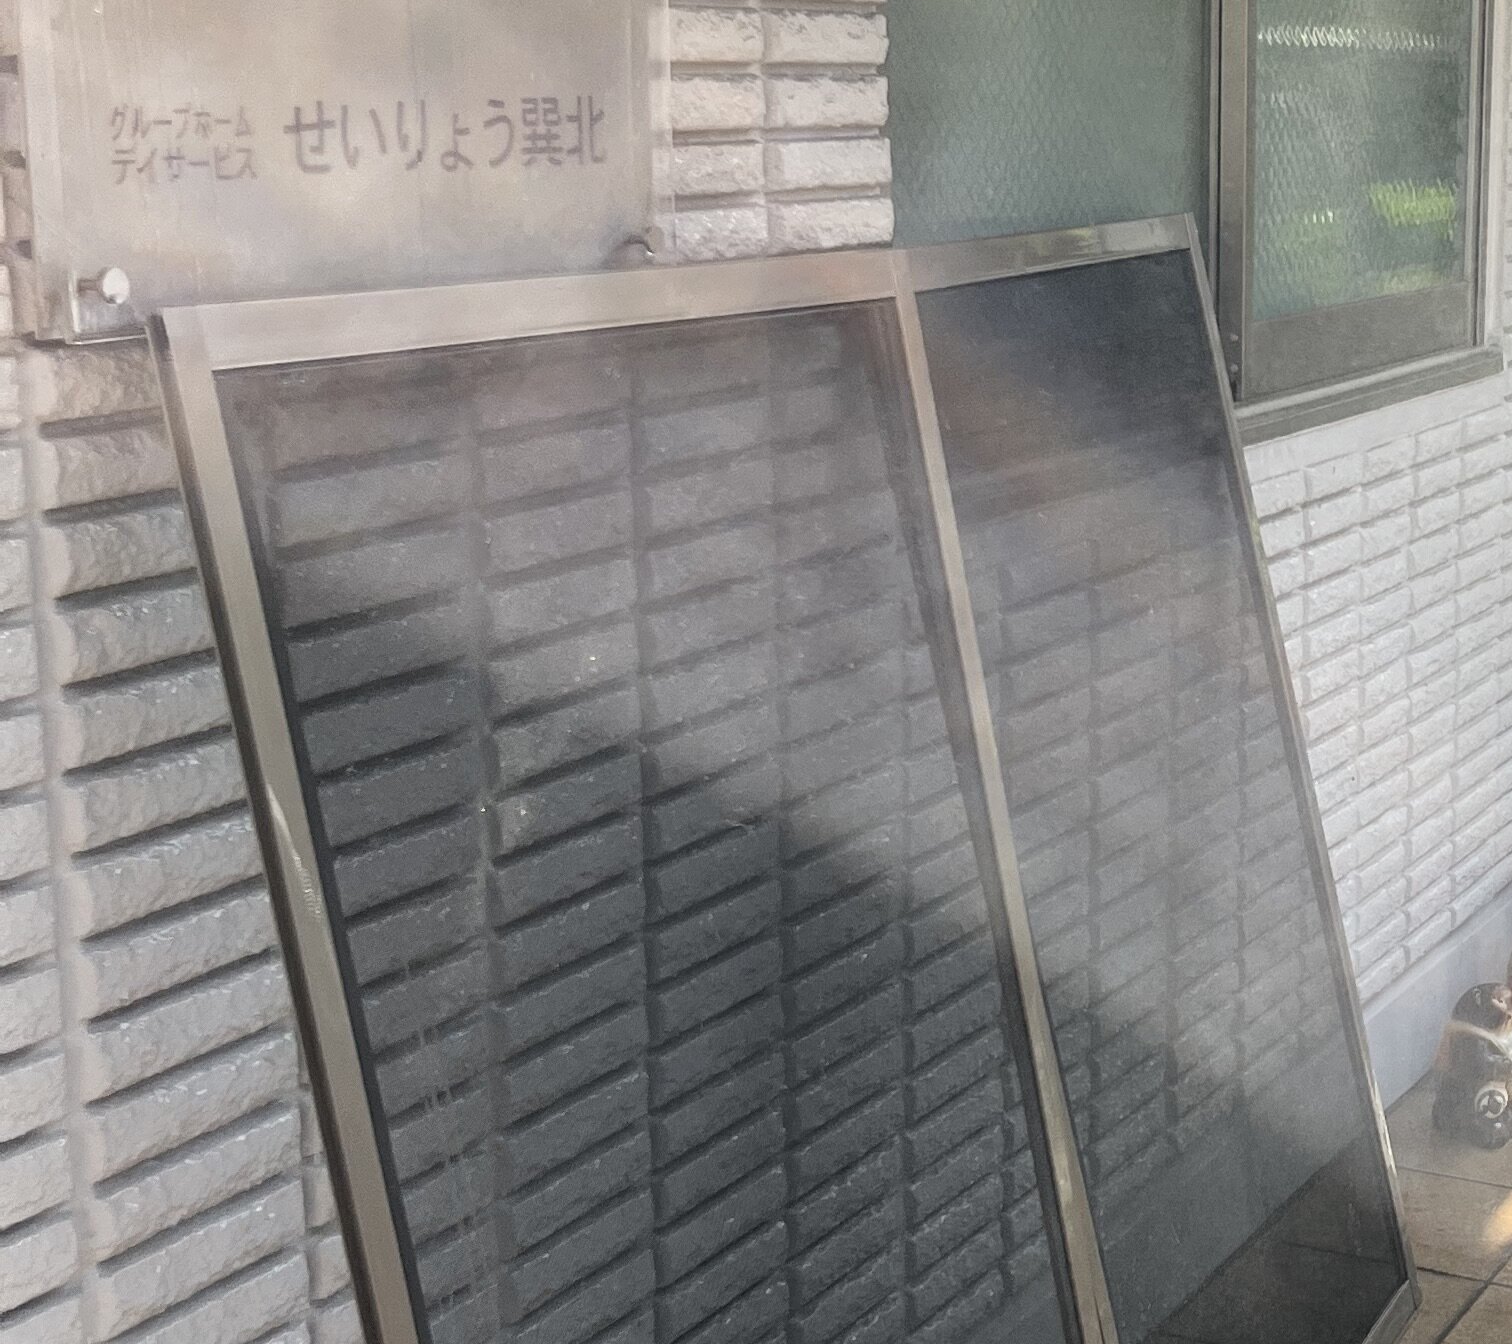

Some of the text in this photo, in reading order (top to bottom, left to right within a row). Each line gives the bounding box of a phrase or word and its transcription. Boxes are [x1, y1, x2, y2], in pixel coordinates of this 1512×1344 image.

[284, 96, 606, 173] せいりょう巽北
